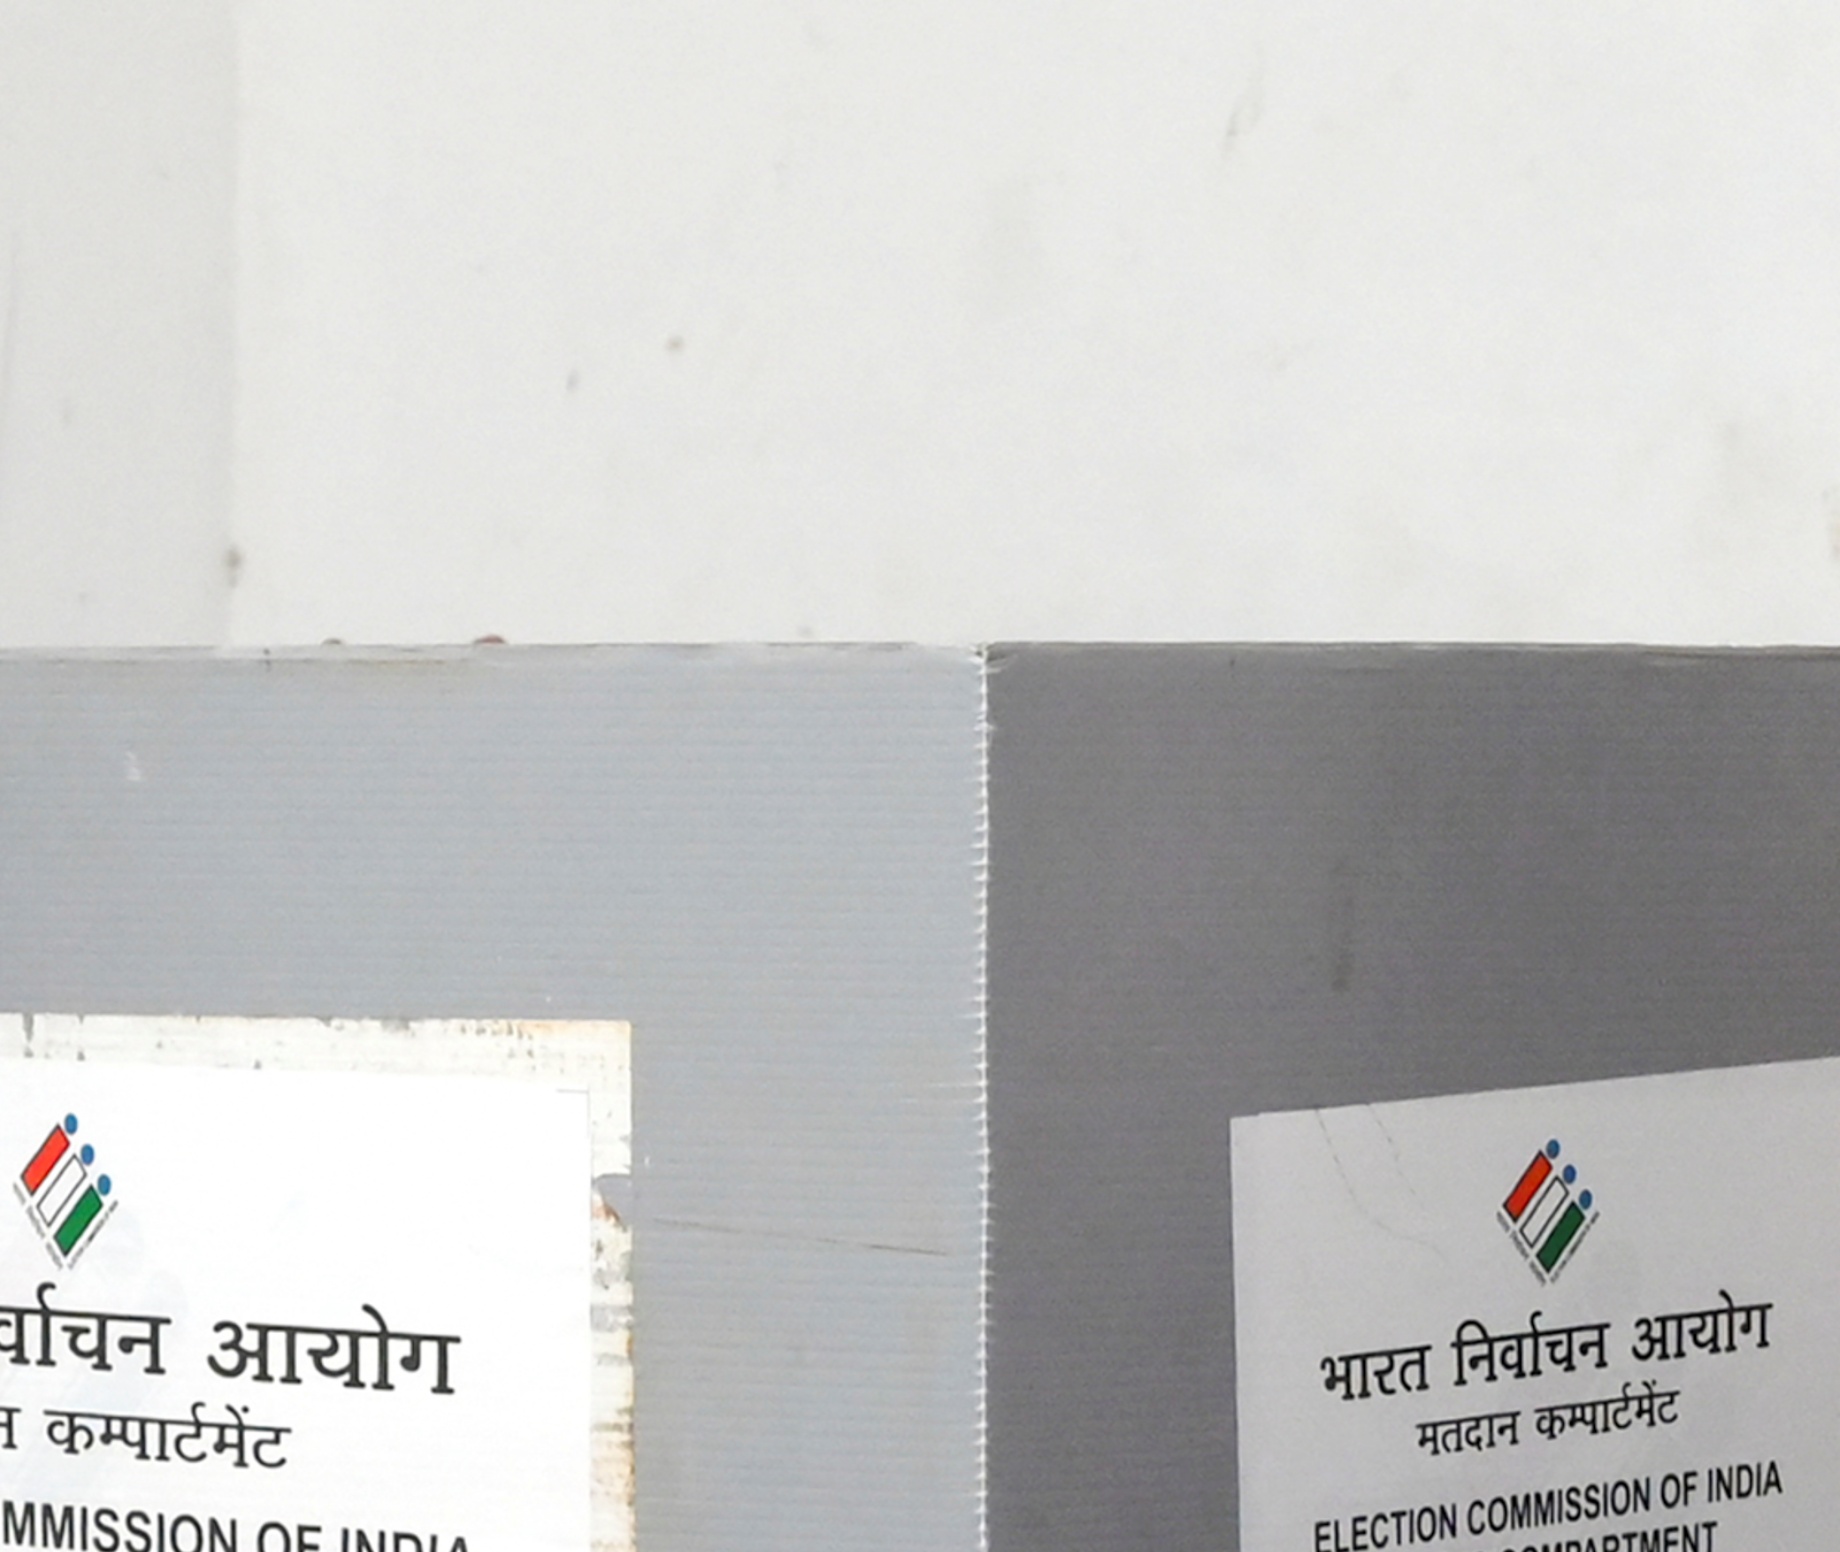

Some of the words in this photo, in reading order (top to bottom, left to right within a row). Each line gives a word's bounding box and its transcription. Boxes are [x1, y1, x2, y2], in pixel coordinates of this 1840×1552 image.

[206, 1303, 463, 1396] आयोग
[1319, 1343, 1434, 1402] भारत
[1449, 1309, 1612, 1388] निर्वाचन
[1630, 1288, 1775, 1363] आयोग
[42, 1400, 293, 1470] कम्पार्टमेंट
[1414, 1410, 1522, 1457] मतदान
[1533, 1379, 1682, 1441] कम्पार्टमेंट
[1466, 1475, 1652, 1537] COMMISSION
[1659, 1469, 1699, 1510] OF
[1706, 1459, 1784, 1504] INDIA
